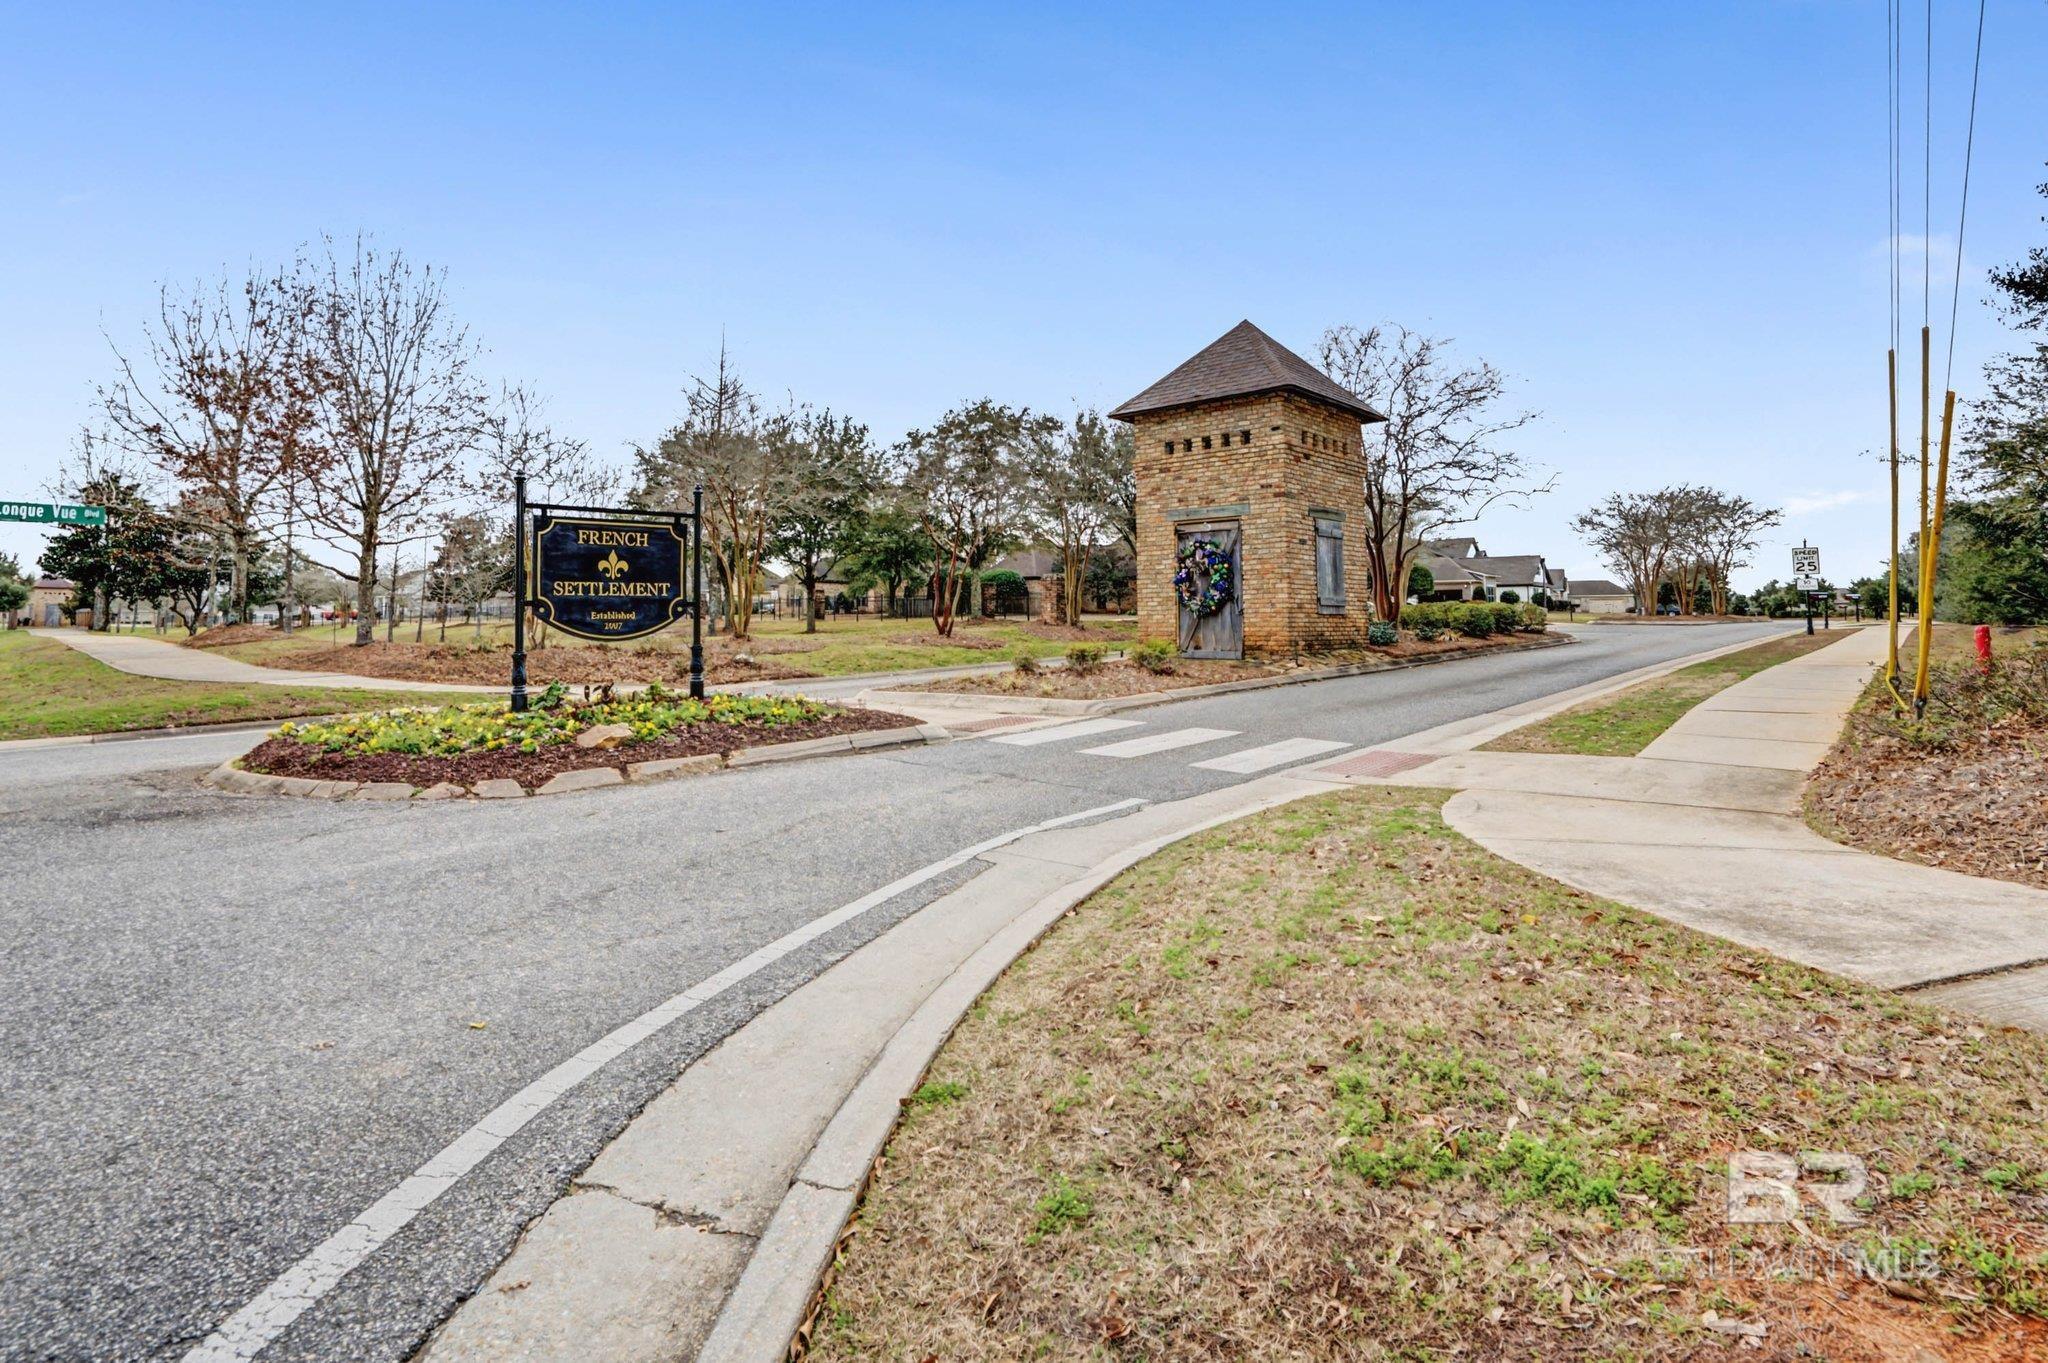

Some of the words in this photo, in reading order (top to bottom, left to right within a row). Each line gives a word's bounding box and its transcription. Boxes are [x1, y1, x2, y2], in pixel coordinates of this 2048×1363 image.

[0, 504, 44, 519] ongue
[53, 504, 77, 519] Vue
[84, 509, 100, 518] Blvd
[578, 529, 649, 547] FRENCH
[1796, 561, 1817, 571] 25
[553, 581, 670, 597] SETTLEMENT
[591, 611, 636, 620] Established
[604, 622, 623, 630] 2007
